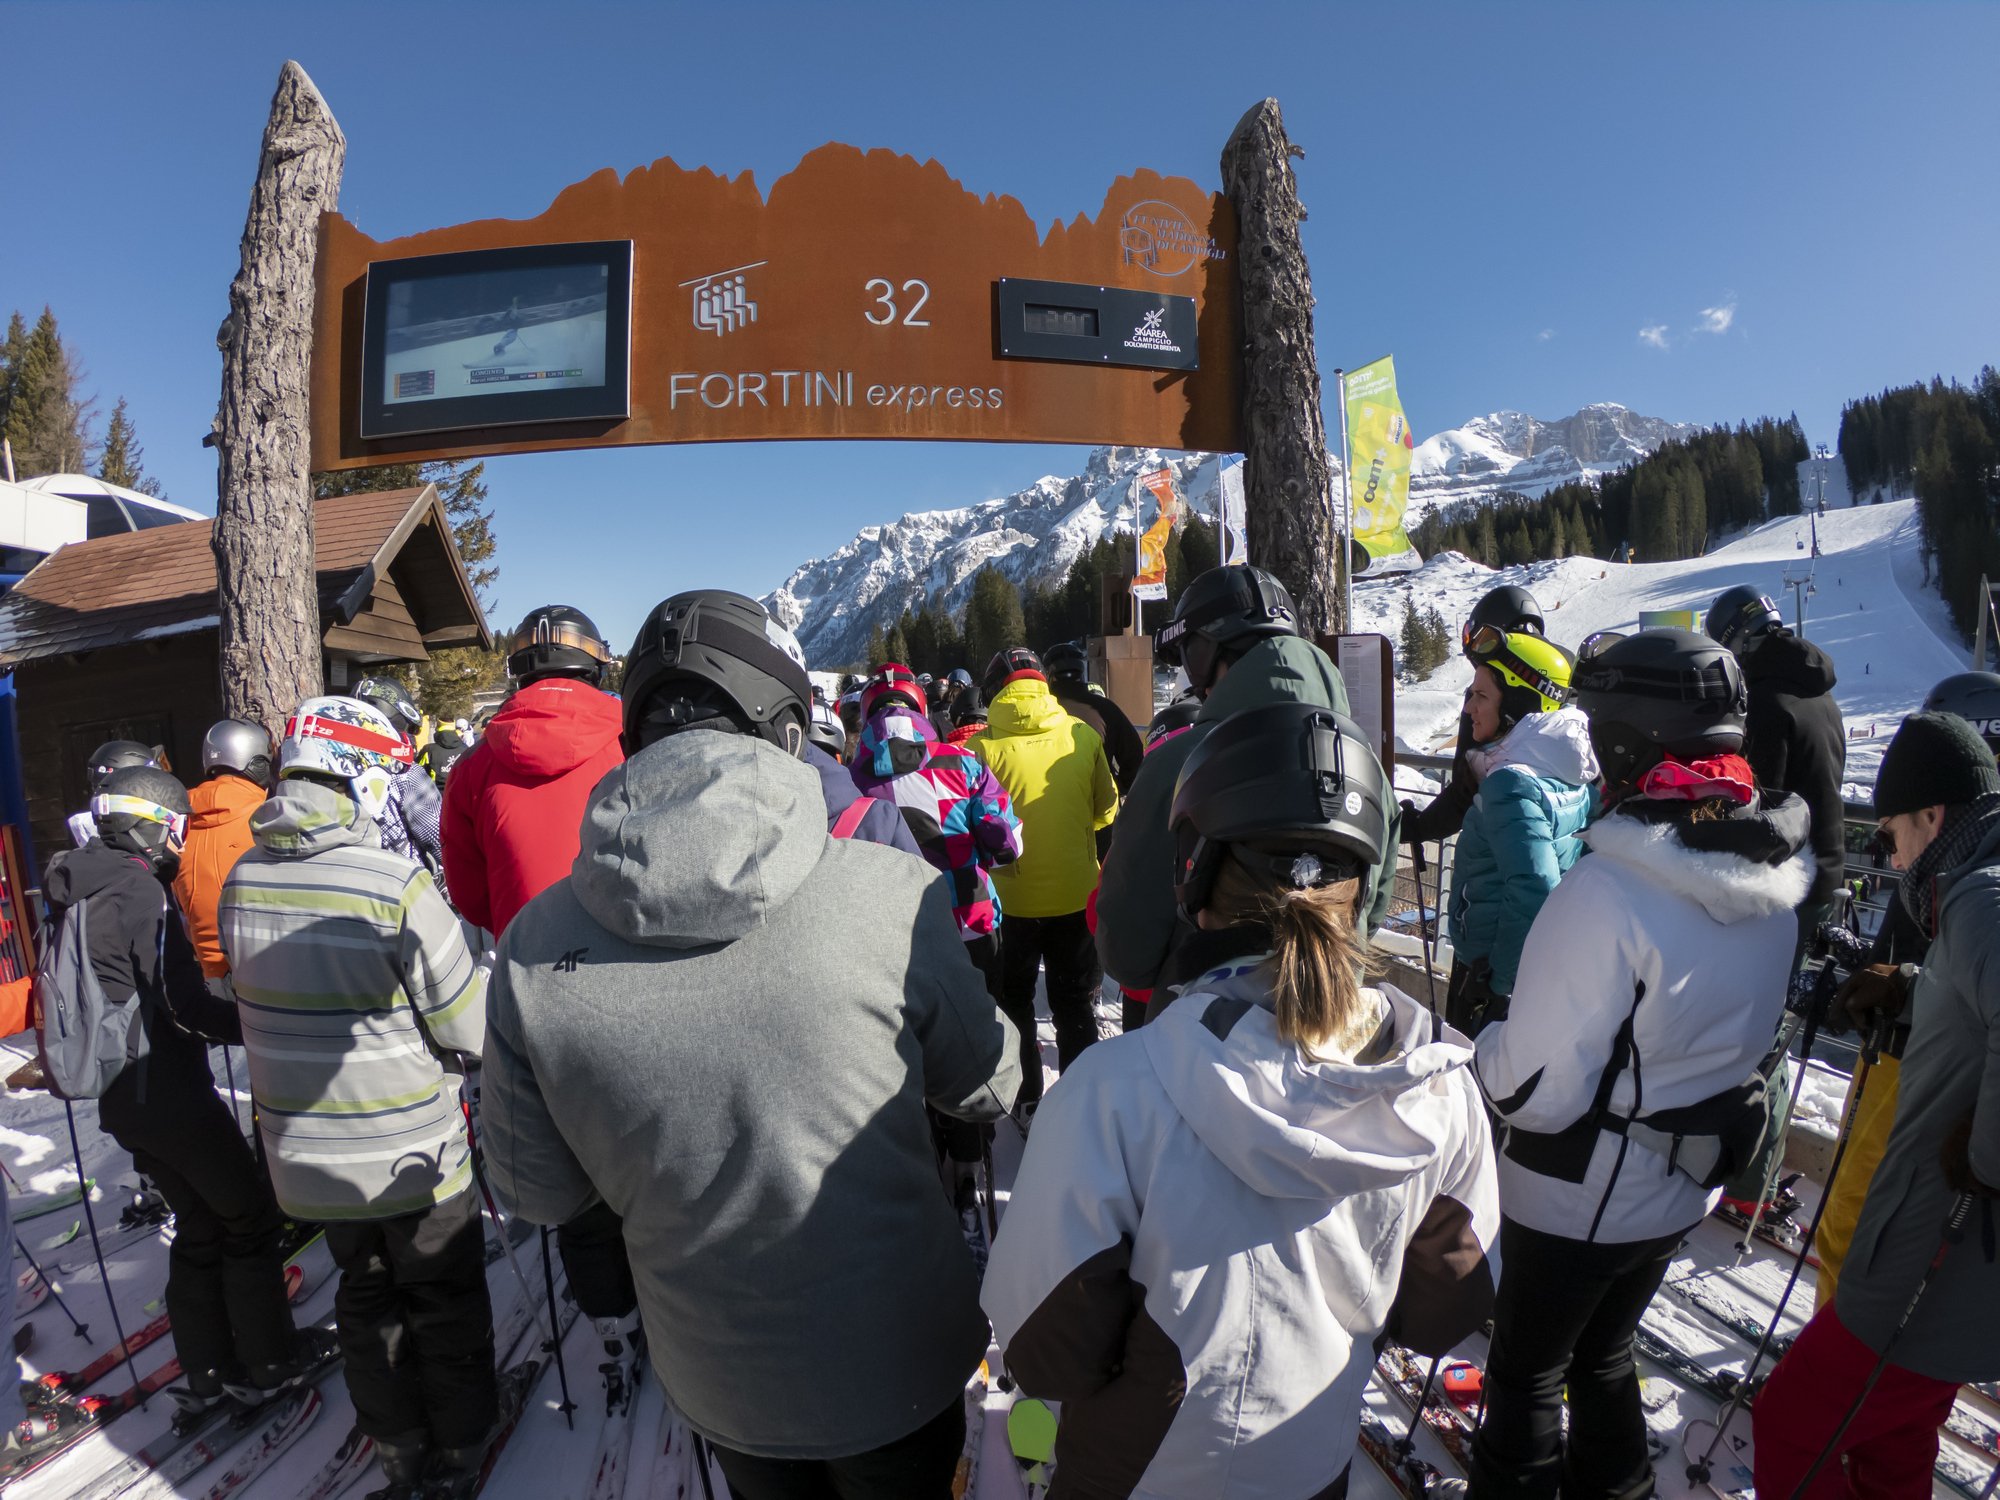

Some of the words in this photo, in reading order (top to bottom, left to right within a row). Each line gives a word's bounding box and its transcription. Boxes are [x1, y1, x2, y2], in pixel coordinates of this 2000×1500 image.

[1157, 229, 1215, 247] MADONNA
[1172, 243, 1226, 260] CAMPIGLI
[864, 278, 930, 326] 32
[1132, 335, 1172, 346] CAMPIGLIO
[1134, 327, 1168, 339] SKIAREA
[1124, 340, 1153, 349] DOLOMITI
[1160, 344, 1181, 352] BRENTA
[670, 370, 854, 410] FORTINI
[866, 383, 1003, 414] express
[1162, 619, 1186, 644] ATOMIC
[1537, 679, 1563, 700] rh+
